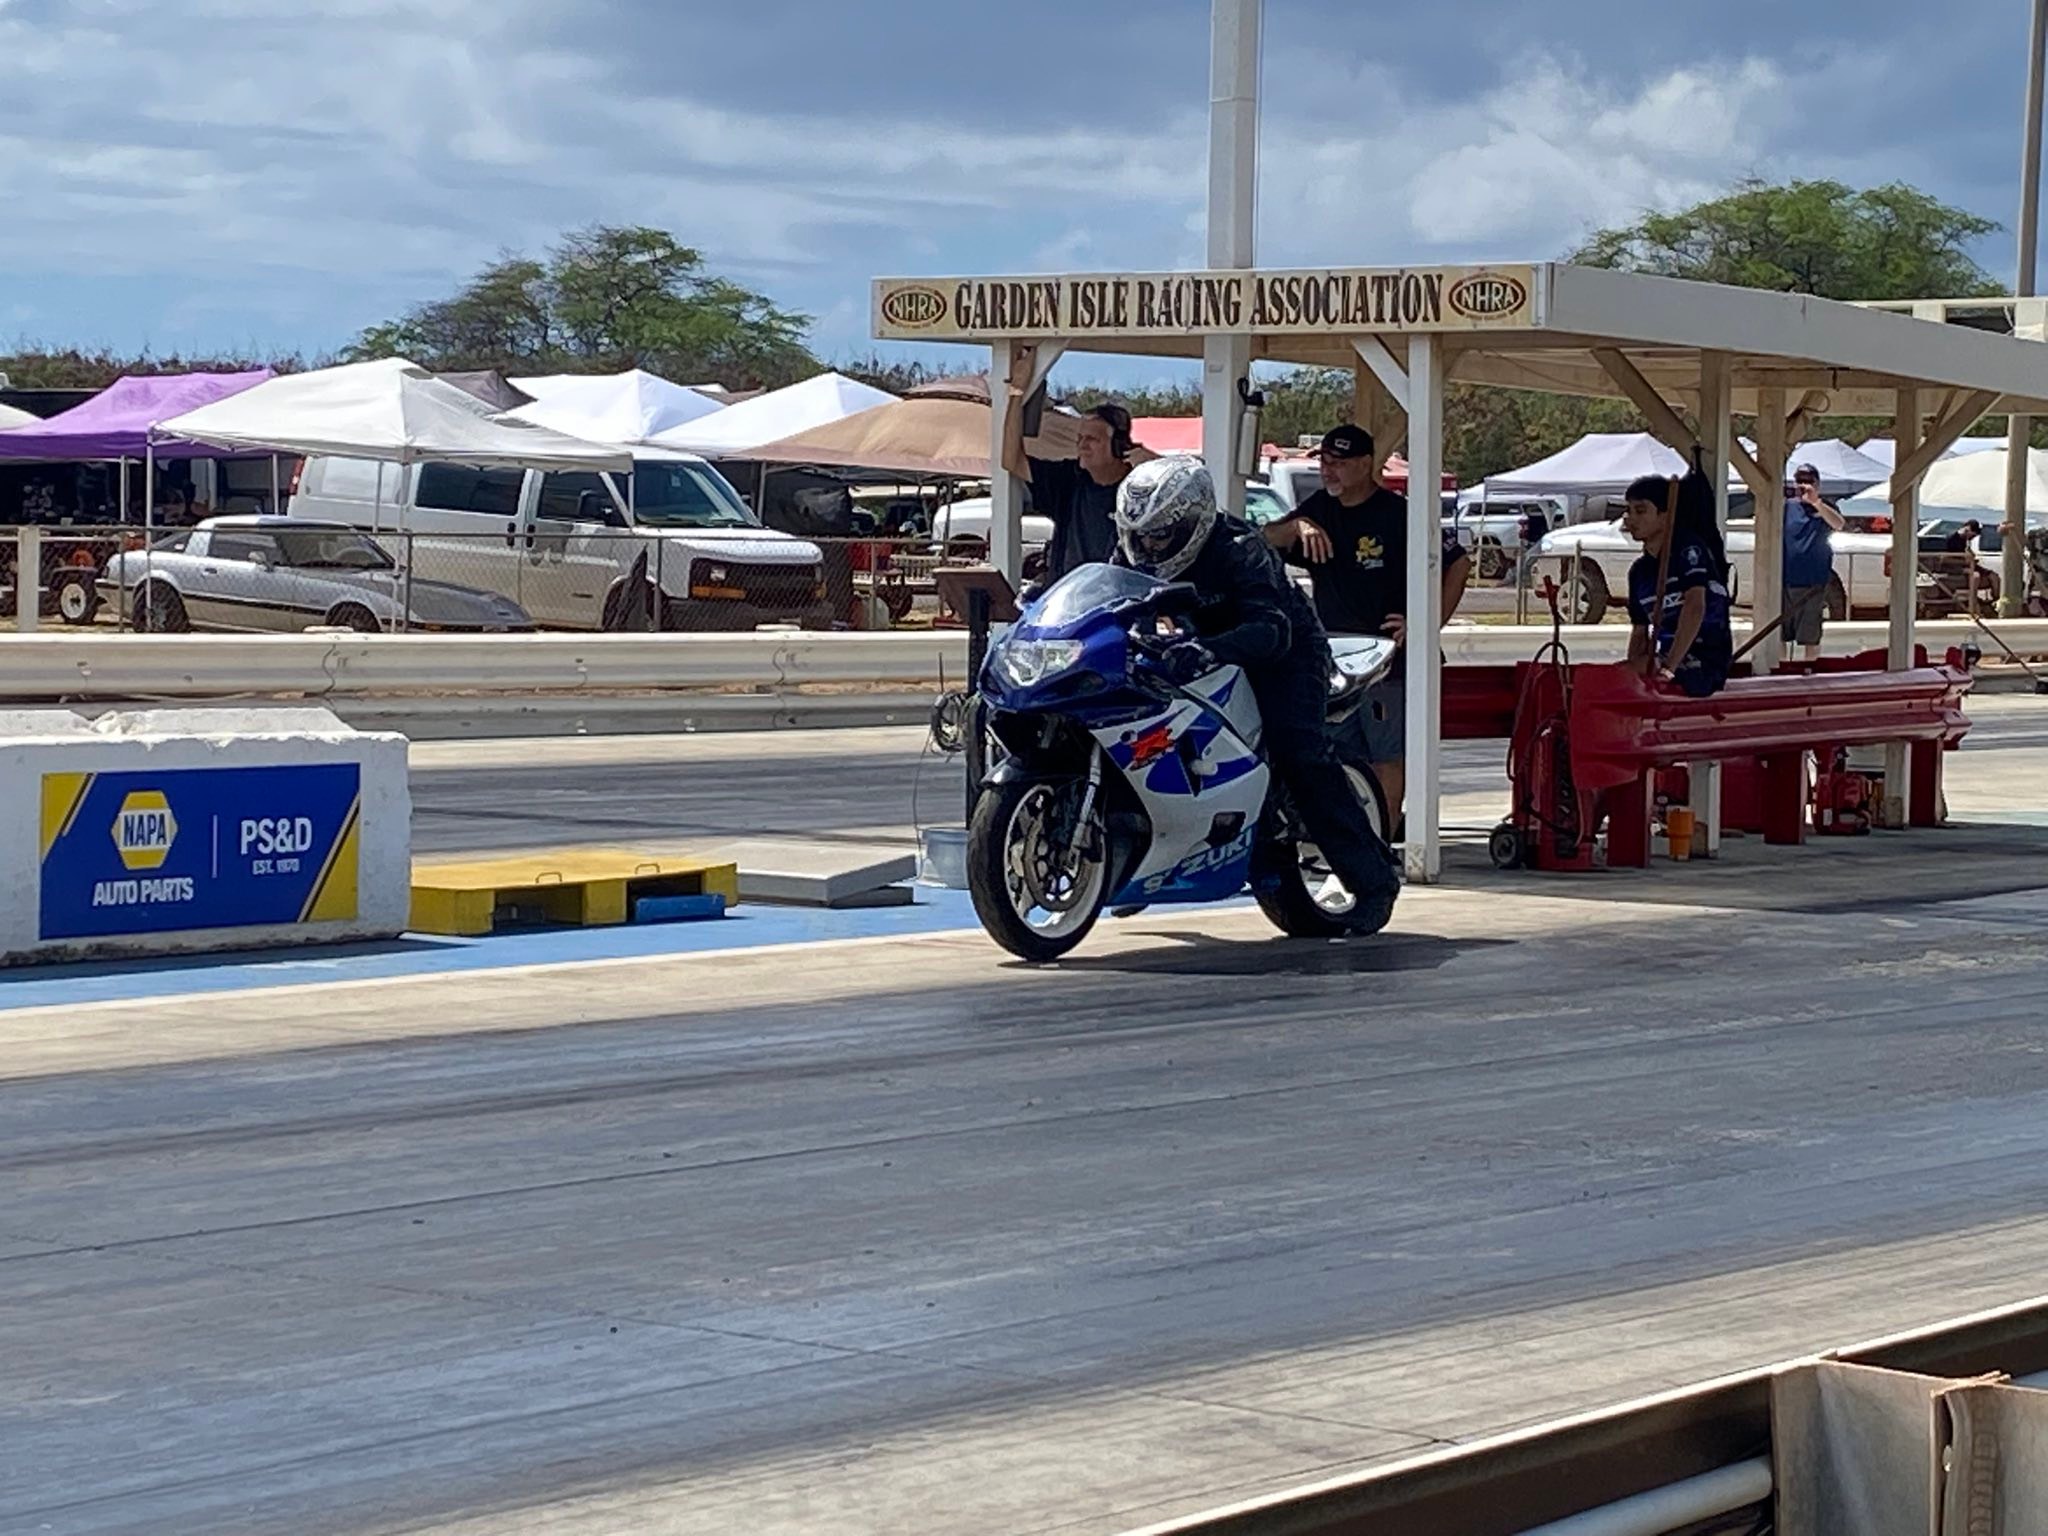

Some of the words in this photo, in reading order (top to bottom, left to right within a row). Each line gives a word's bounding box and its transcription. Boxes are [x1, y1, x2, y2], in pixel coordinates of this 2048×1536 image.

[891, 293, 938, 320] NHRA
[955, 281, 1061, 329] GARDEN
[1069, 279, 1129, 328] ISLE
[1136, 277, 1241, 327] RACING
[1249, 273, 1444, 326] ASSOCIATION
[1460, 282, 1516, 311] NHRA
[123, 813, 167, 847] NAPA
[240, 817, 312, 855] PS&D
[92, 881, 138, 906] AUTO
[142, 877, 194, 902] PARTS
